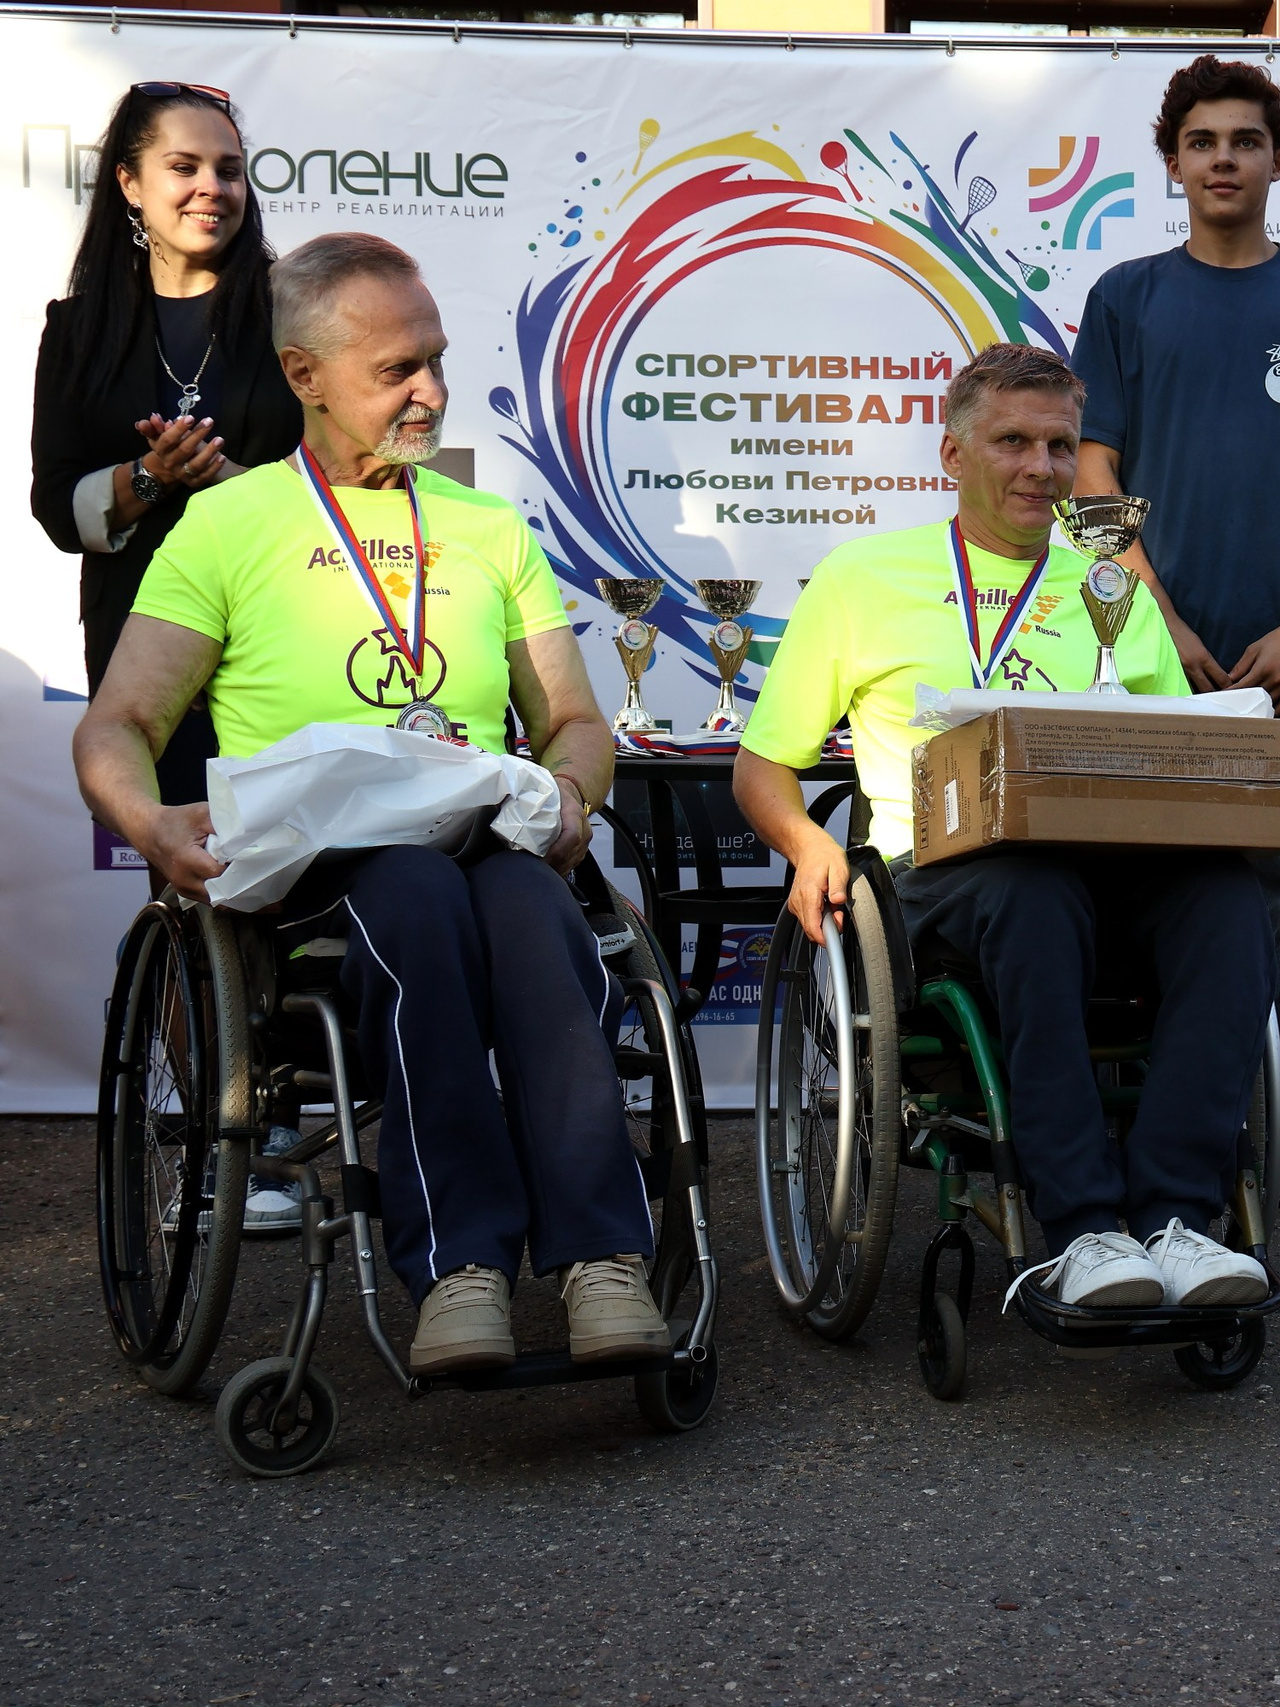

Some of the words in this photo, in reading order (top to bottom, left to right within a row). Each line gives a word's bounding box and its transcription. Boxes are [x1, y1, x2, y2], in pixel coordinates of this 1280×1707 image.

[23, 123, 508, 206] Проление
[336, 202, 505, 217] РЕАБИЛИТАЦИИ
[635, 350, 953, 380] СПОРТИВНЫЙ
[730, 437, 853, 456] имени
[623, 468, 774, 491] Любови
[715, 502, 877, 526] Кезиной
[306, 538, 415, 570] Acilles
[424, 586, 451, 596] ussia
[943, 588, 1017, 606] Ahille
[1034, 624, 1062, 639] Russia
[730, 852, 754, 861] фонд
